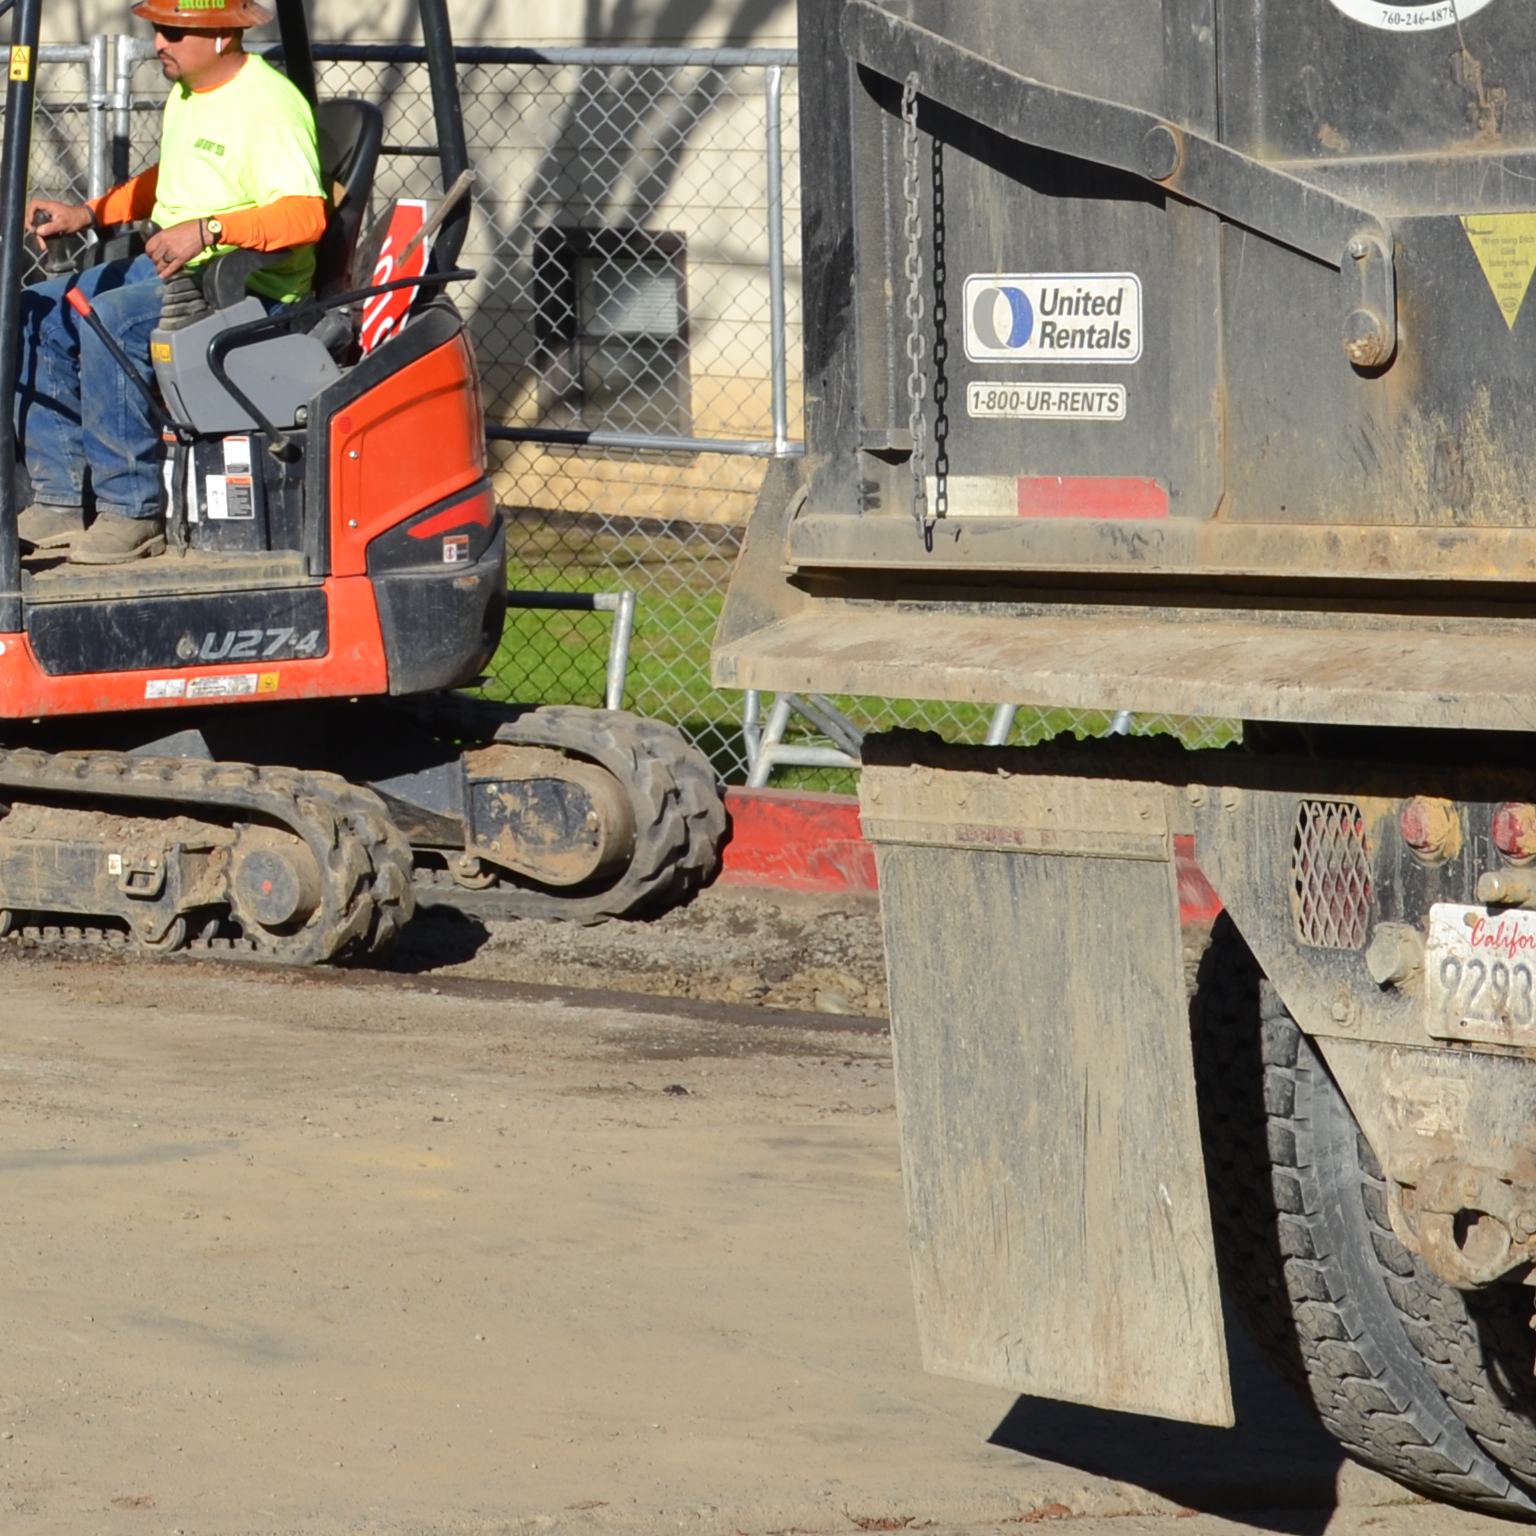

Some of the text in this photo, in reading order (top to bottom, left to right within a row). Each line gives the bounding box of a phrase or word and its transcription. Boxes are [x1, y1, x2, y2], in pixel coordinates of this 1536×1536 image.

[1039, 288, 1123, 317] United
[1039, 320, 1131, 350] Rentals
[972, 390, 1120, 413] 1-800-UR-RENTS
